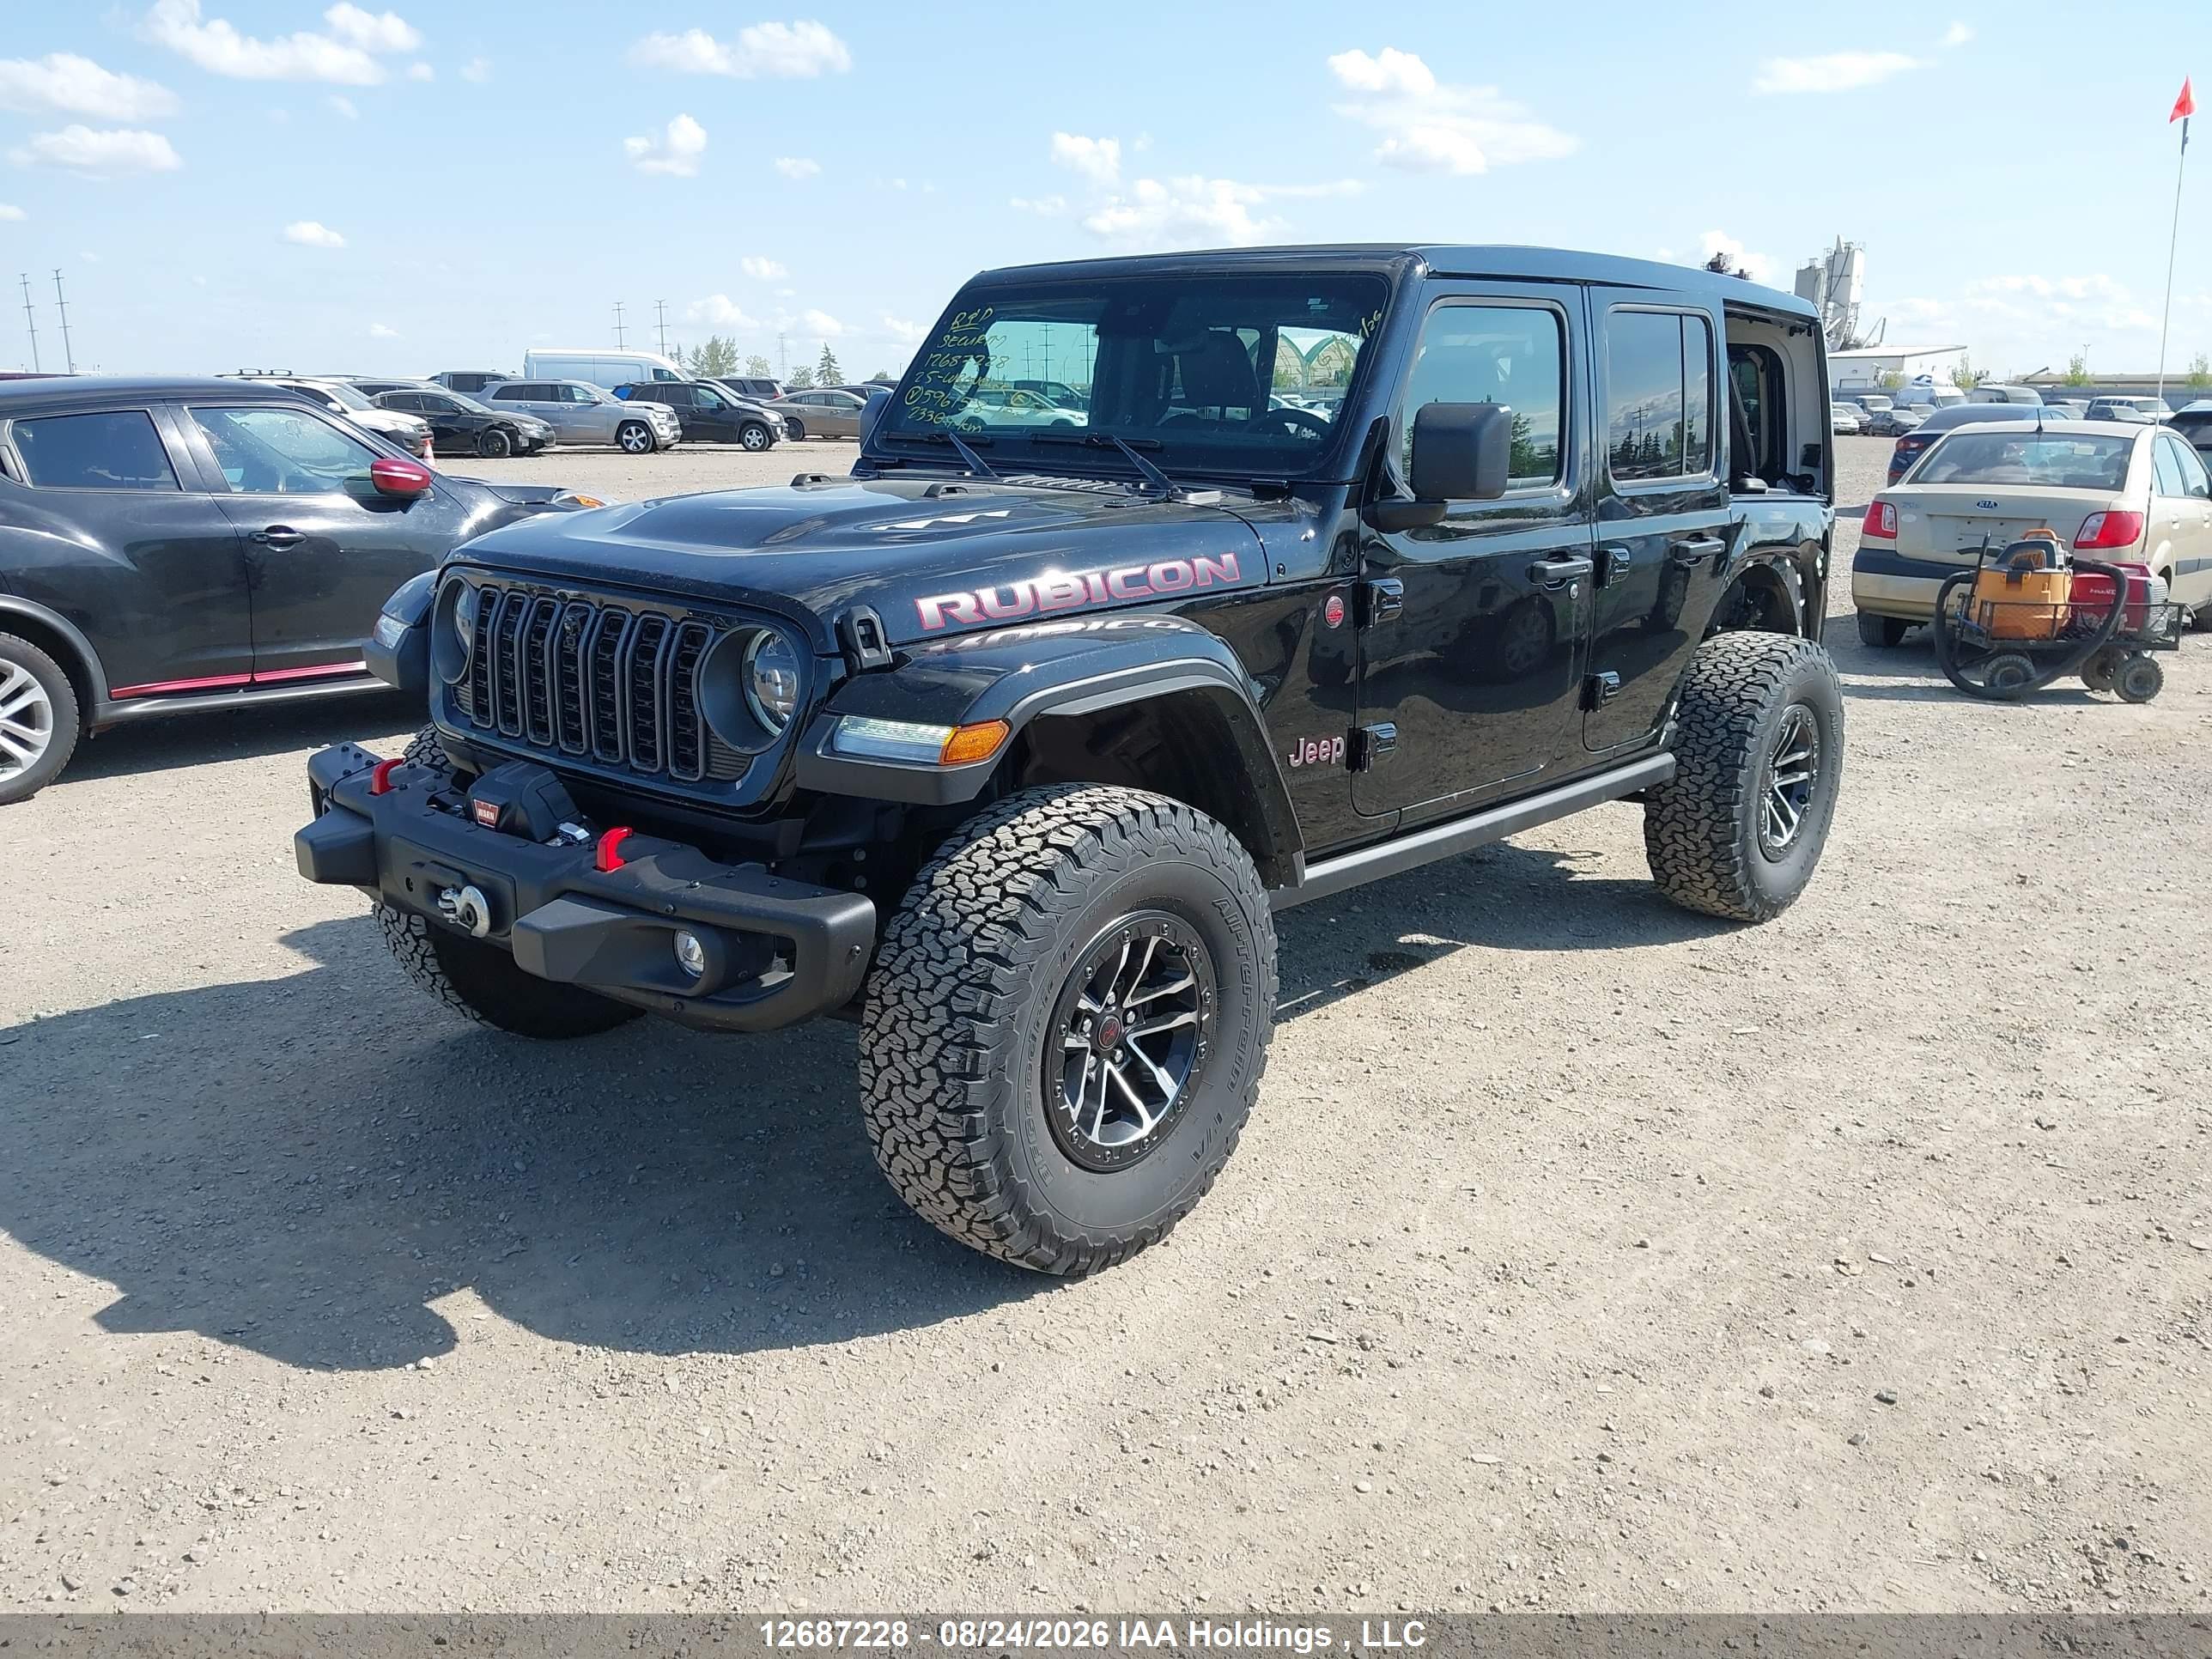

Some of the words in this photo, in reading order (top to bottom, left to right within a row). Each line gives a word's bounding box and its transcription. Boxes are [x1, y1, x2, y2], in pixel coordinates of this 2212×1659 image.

[915, 551, 1241, 630] RUBICON
[1287, 736, 1346, 769] Jeep
[477, 808, 495, 820] WARN
